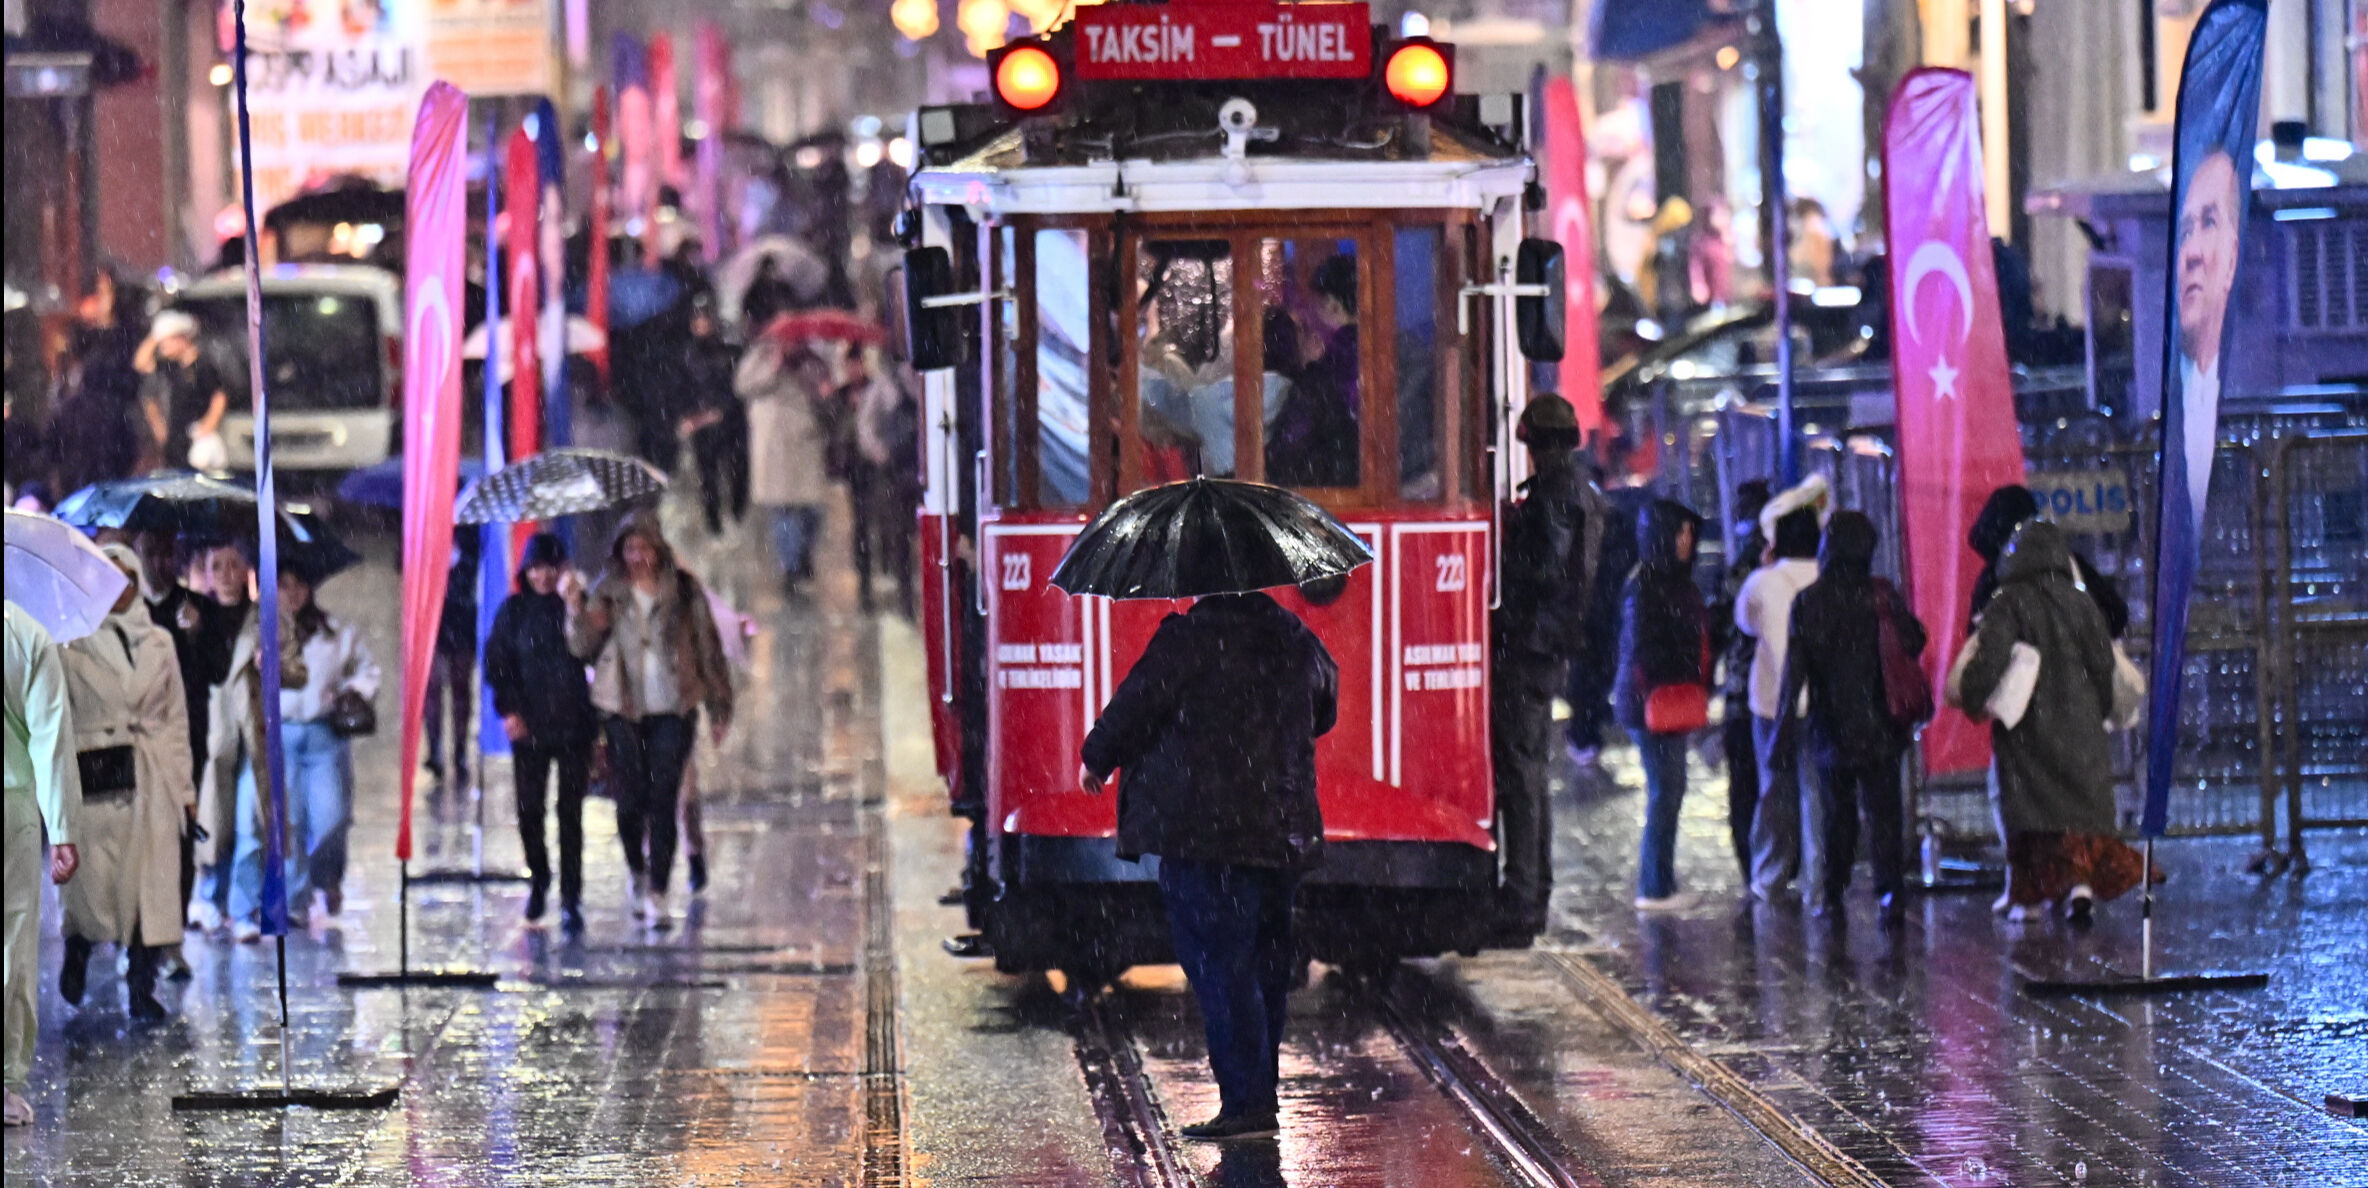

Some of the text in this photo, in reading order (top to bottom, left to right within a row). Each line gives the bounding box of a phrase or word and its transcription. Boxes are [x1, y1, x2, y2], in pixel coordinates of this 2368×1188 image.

[1085, 14, 1195, 63] TAKSİM
[1257, 12, 1354, 61] TÜNEL
[1002, 553, 1031, 591] 223
[1435, 553, 1466, 592] 223
